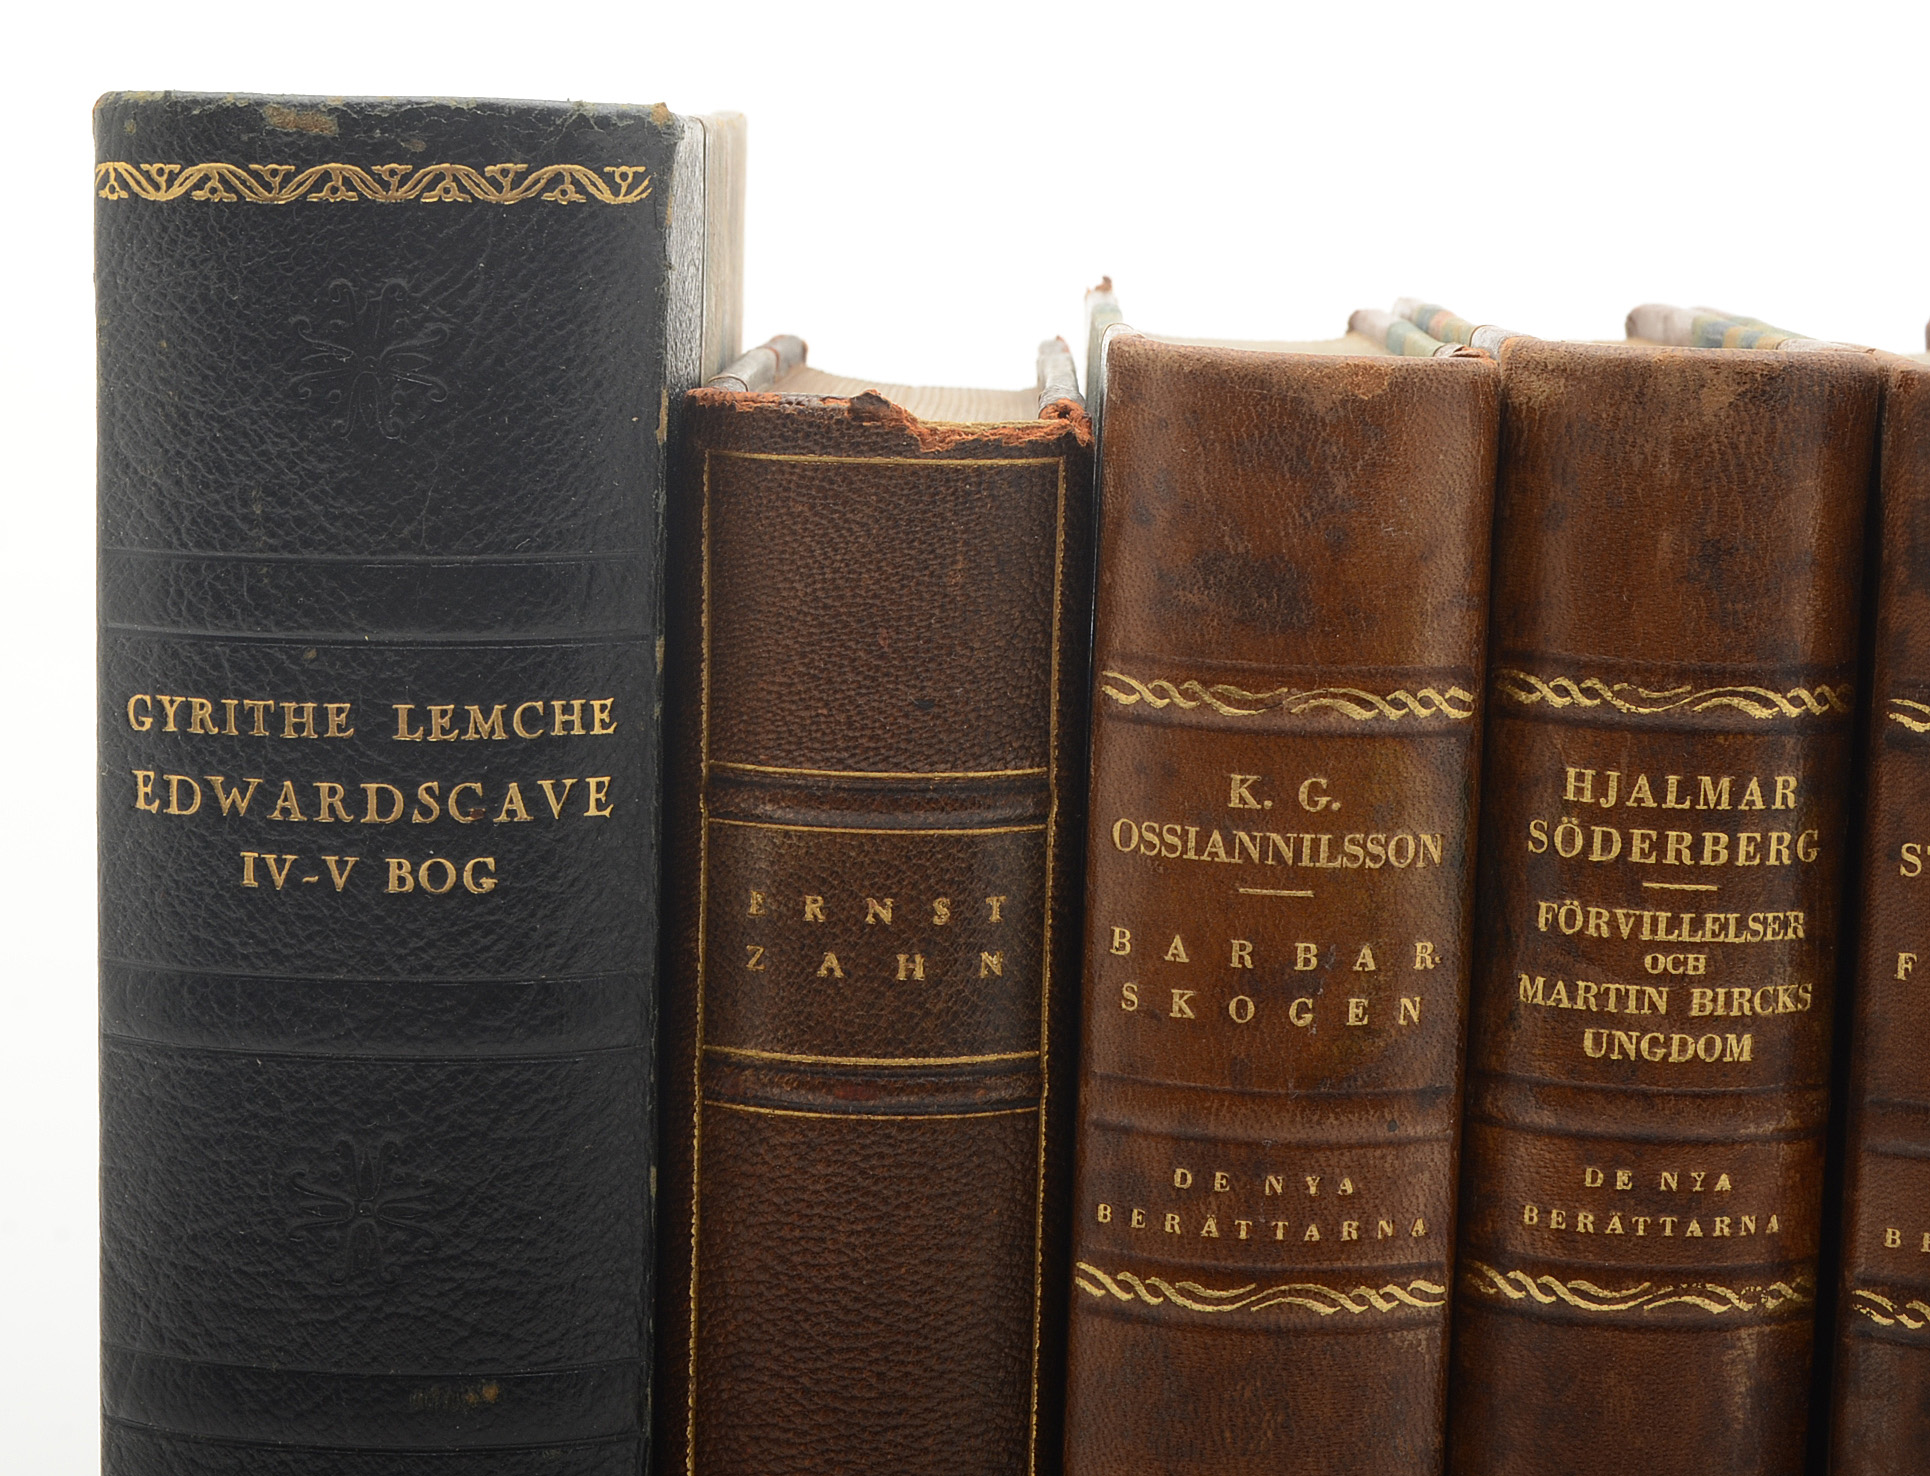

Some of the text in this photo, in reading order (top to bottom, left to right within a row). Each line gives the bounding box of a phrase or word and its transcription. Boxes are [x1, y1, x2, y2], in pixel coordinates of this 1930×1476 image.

[127, 693, 618, 742] GYRITHE LEMCHE
[1227, 773, 1341, 813] K. G.
[1562, 766, 1798, 811] HJALMAR
[1112, 817, 1442, 869] OSSIANNILSSON
[1528, 816, 1818, 867] SÖDERBERG
[1899, 842, 1930, 877] S
[386, 857, 498, 894] BOG
[747, 890, 1006, 926] ERNST
[1538, 899, 1805, 944] FÖRVILLELSER
[746, 946, 1002, 981] ZAHN
[1644, 953, 1707, 975] OCH
[1121, 982, 1421, 1027] SKOGEN
[1519, 974, 1812, 1017] MARTIN BIRCKS
[1583, 1028, 1752, 1063] UNGDOM
[1173, 1168, 1354, 1196] DE NYA
[1584, 1167, 1732, 1192] DE NYA
[1097, 1203, 1426, 1242] BERÄTTARNA
[1523, 1204, 1779, 1237] BERÄTTARNA
